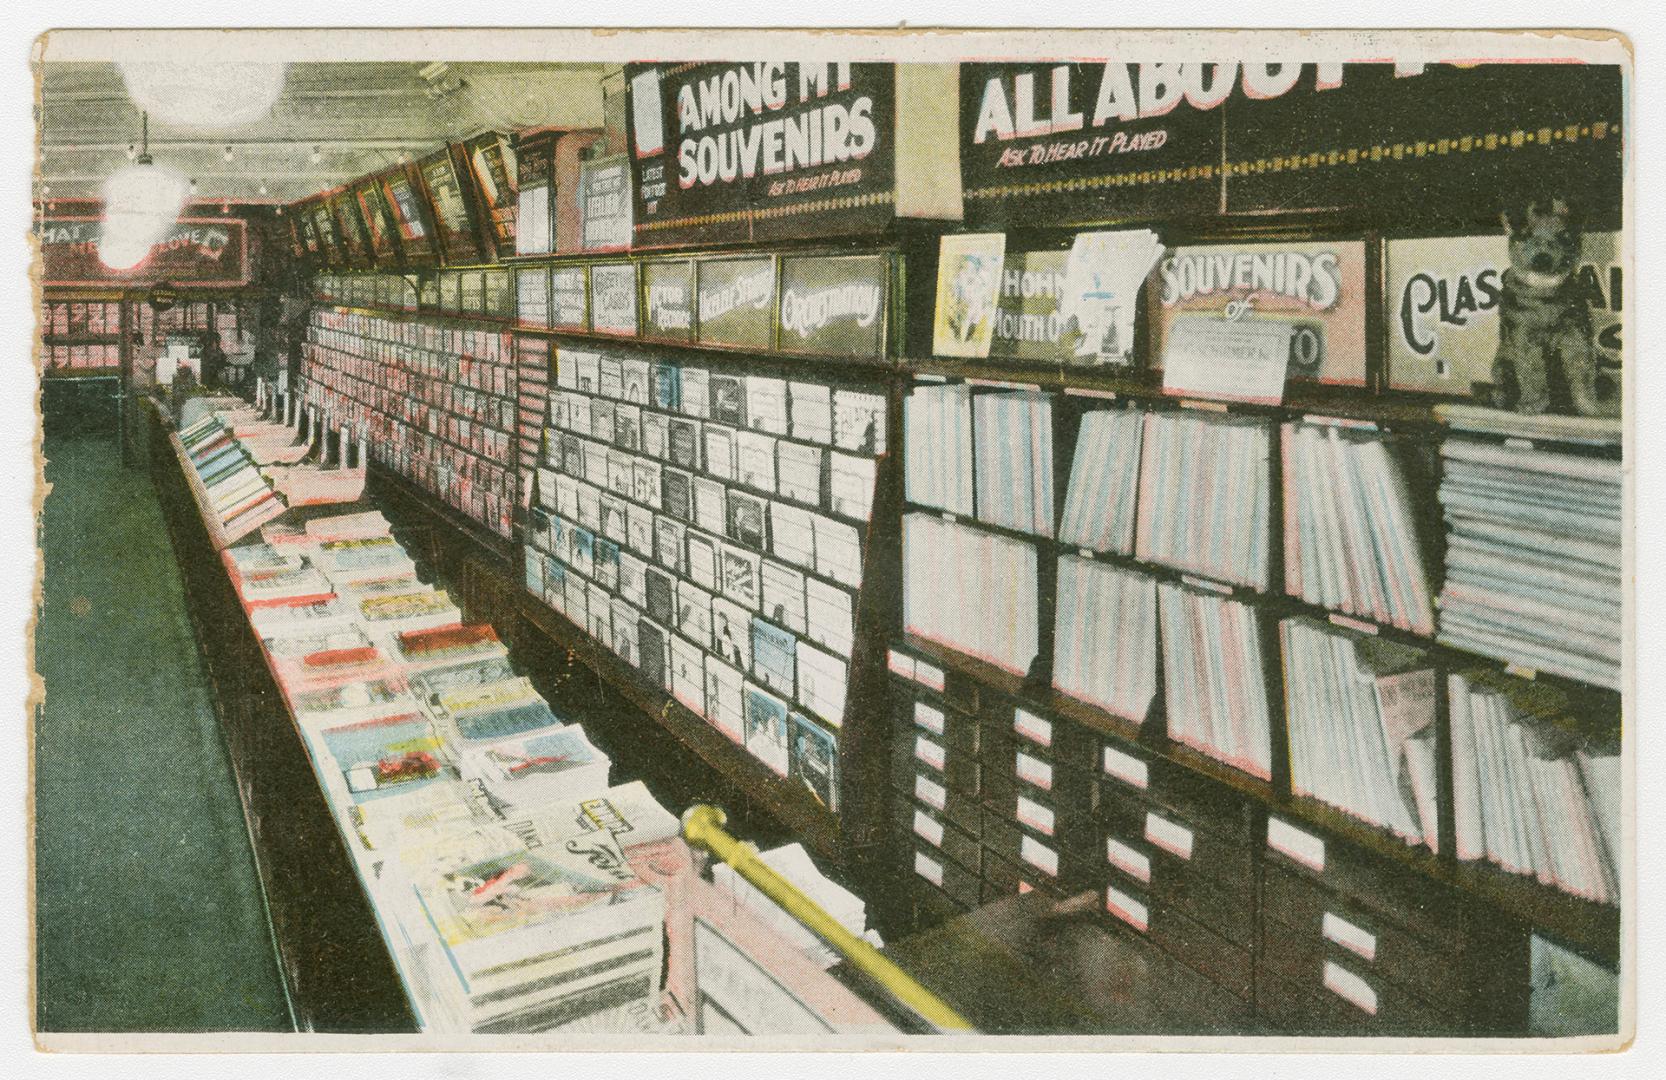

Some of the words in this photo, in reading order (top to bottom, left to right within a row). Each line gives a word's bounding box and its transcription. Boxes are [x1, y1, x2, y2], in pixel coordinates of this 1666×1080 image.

[677, 61, 788, 134] AMONG
[973, 65, 1084, 144] ALL
[678, 97, 876, 189] SOUVENIRS
[995, 147, 1029, 168] ASK
[1028, 145, 1045, 165] TO
[1045, 141, 1089, 162] HEAR
[1088, 137, 1109, 157] IT
[1108, 129, 1168, 154] PLAYED
[1159, 251, 1342, 309] SOUVENIRS
